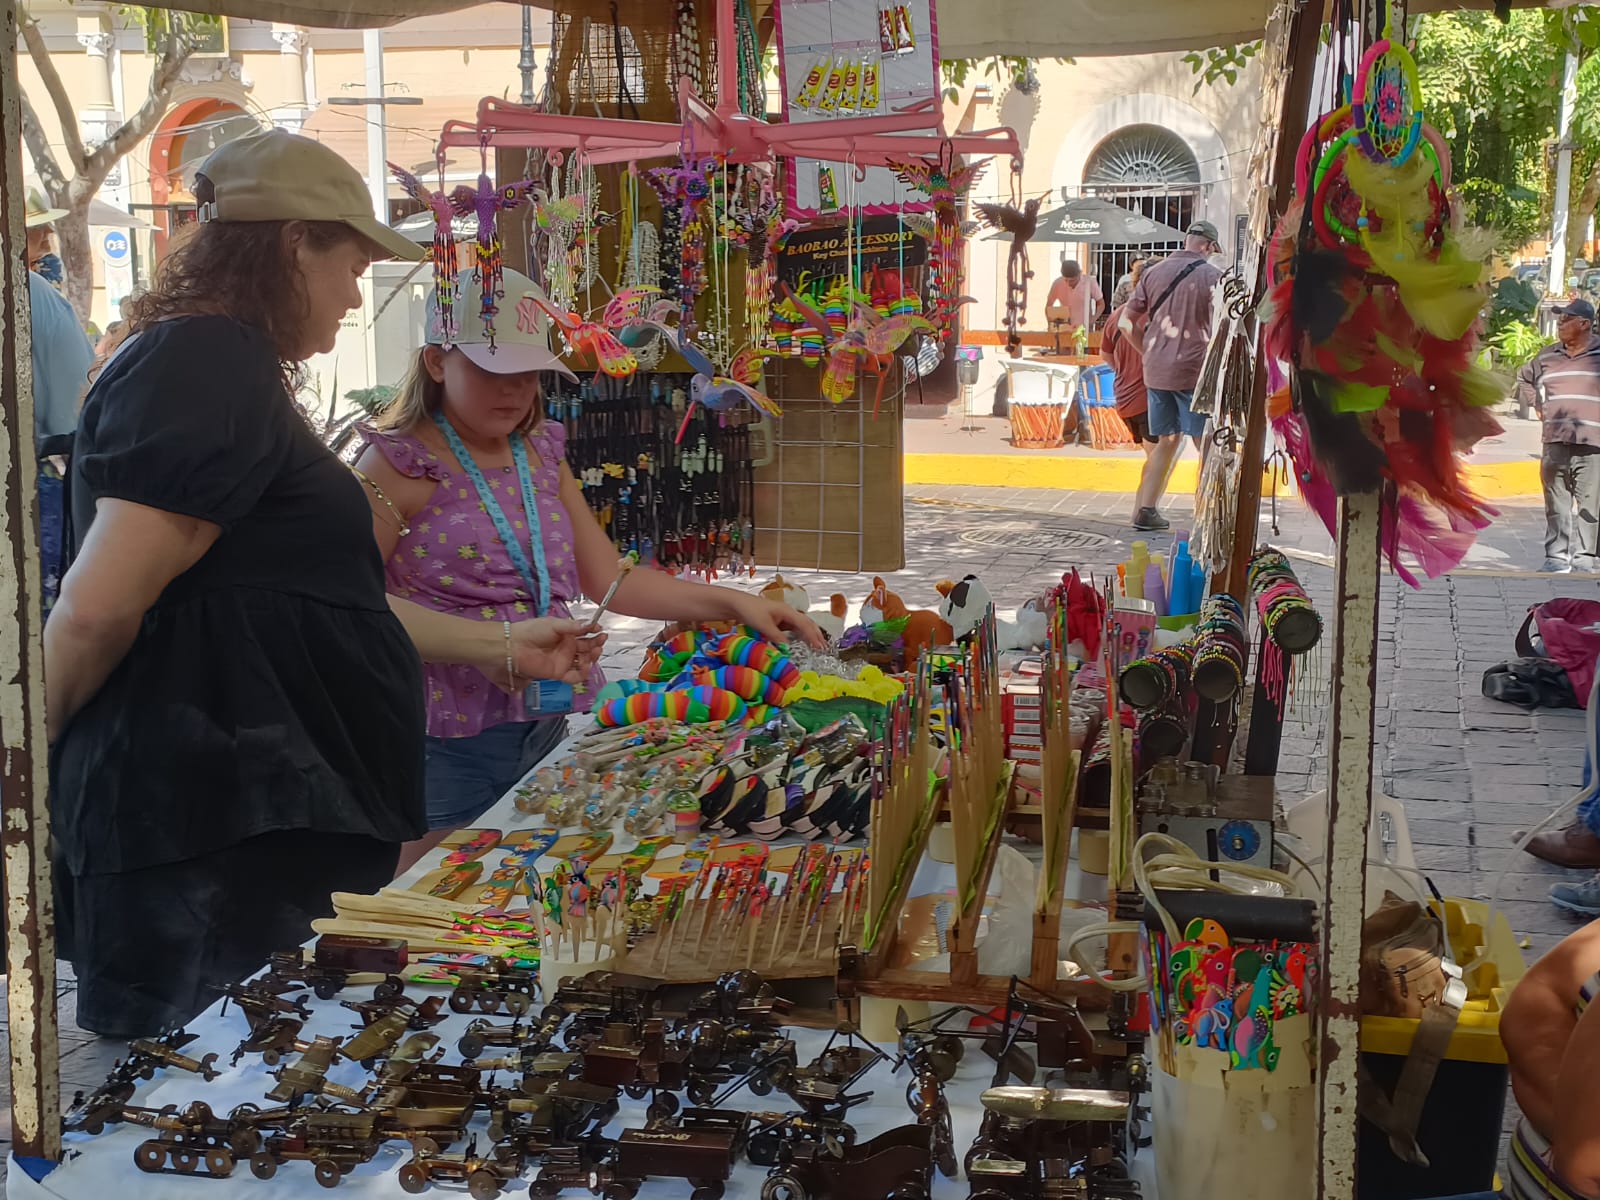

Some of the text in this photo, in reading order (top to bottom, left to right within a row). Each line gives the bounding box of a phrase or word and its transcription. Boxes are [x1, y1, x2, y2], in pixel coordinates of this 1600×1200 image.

[1060, 219, 1100, 229] Modelo
[787, 239, 839, 256] BAOBAO
[812, 252, 829, 260] Key
